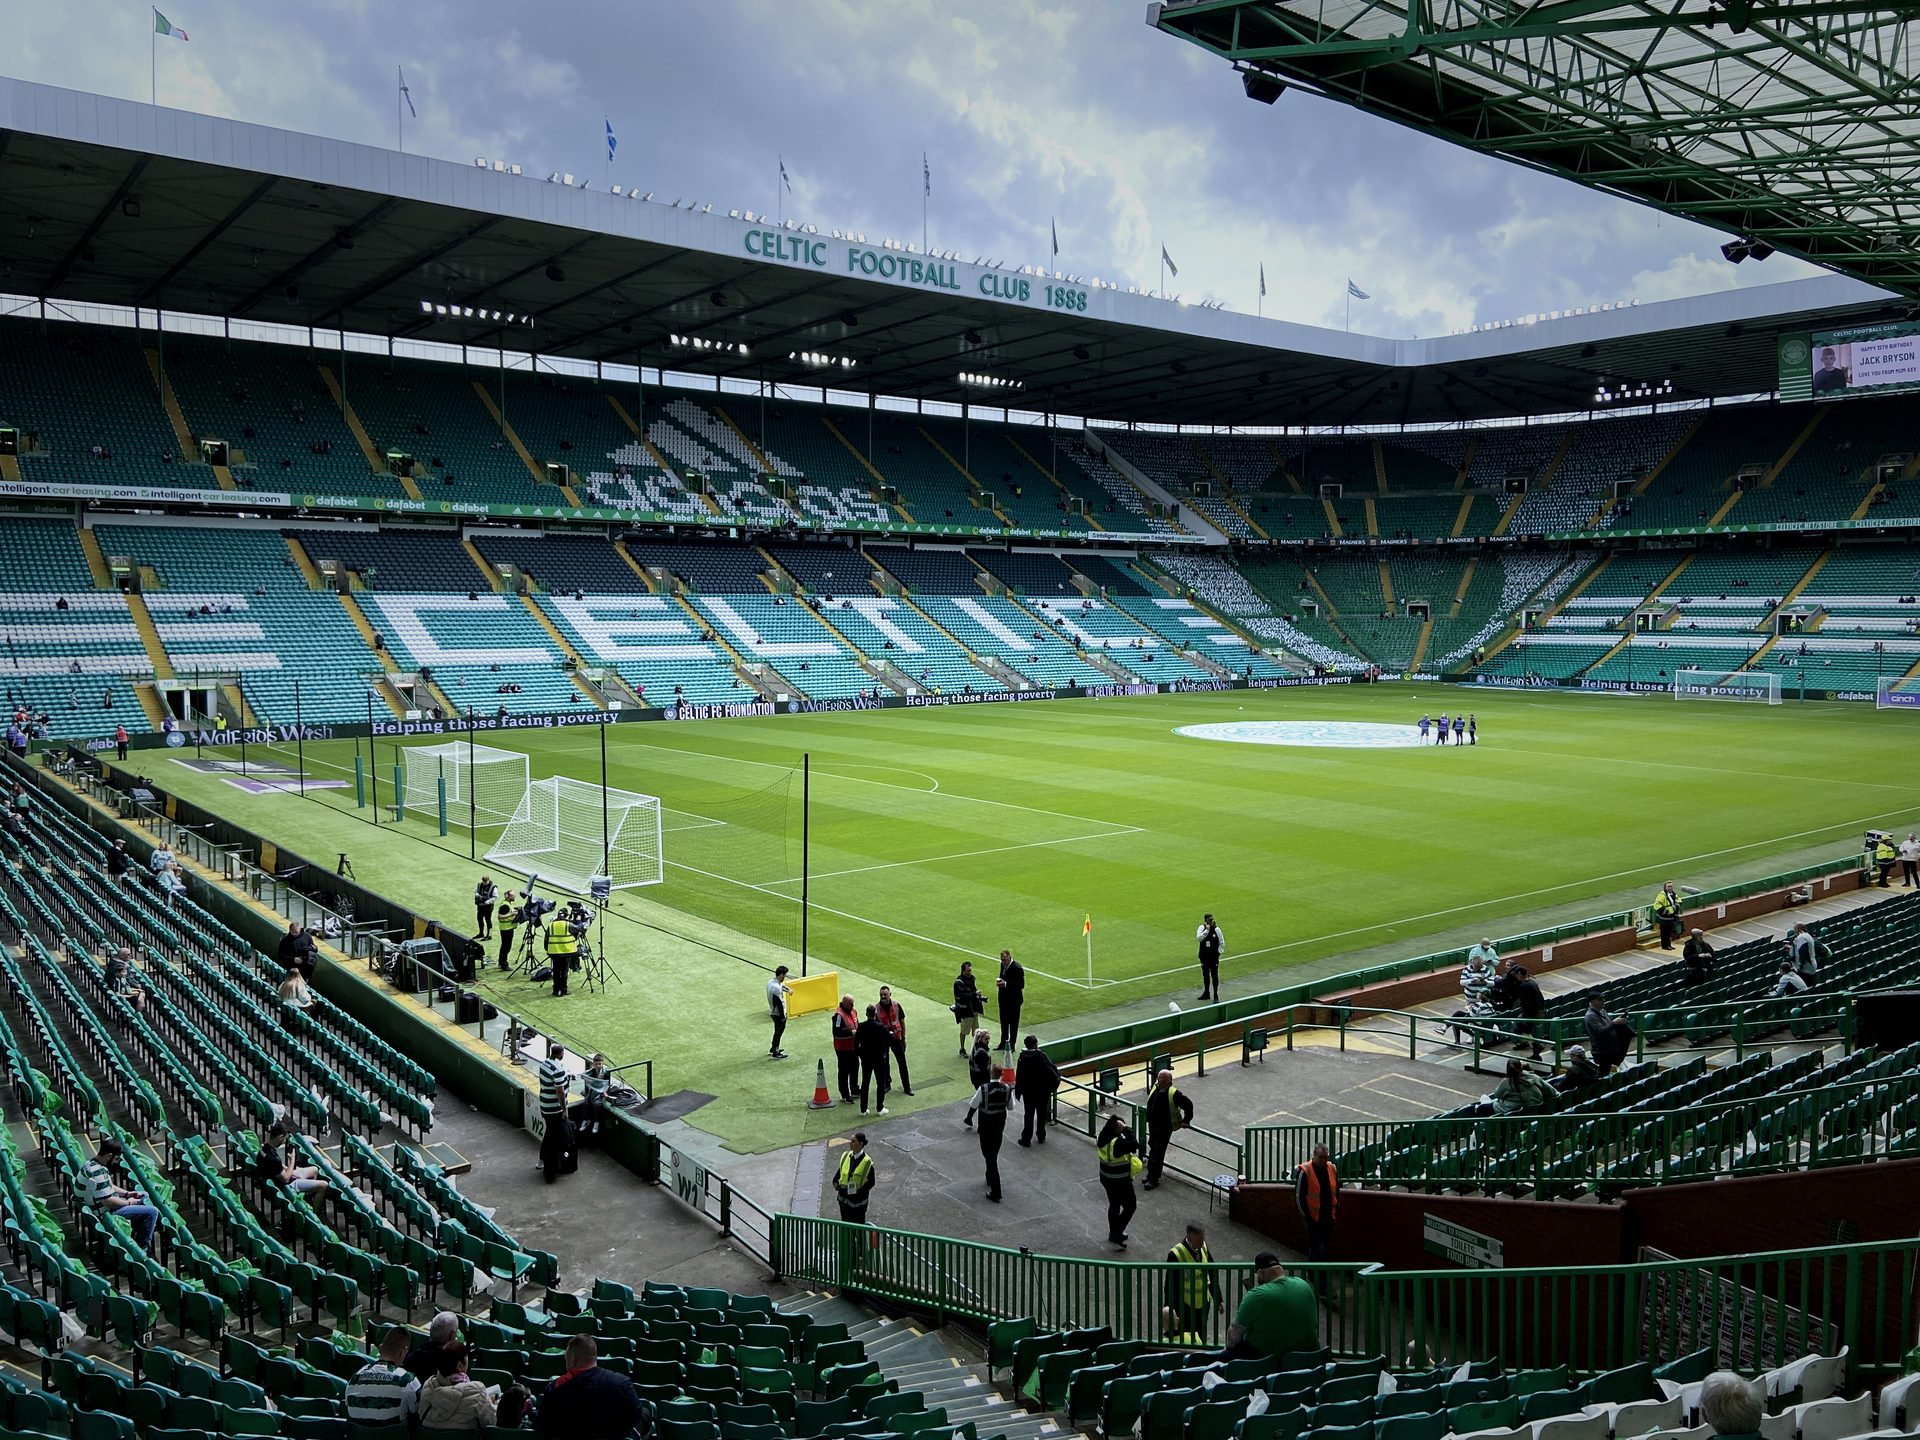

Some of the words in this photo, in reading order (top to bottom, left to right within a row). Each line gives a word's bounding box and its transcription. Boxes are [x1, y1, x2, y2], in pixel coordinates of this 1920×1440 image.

[744, 229, 827, 266] CELTIC
[848, 247, 961, 290] FOOTBALL
[979, 273, 1031, 302] CLUB
[1045, 284, 1088, 312] 1888
[1853, 327, 1882, 335] FOOTBALL
[1860, 356, 1881, 366] JACK
[1882, 352, 1915, 363] BRYSON
[52, 487, 70, 495] car
[203, 493, 220, 501] car
[316, 495, 359, 508] dafabet
[386, 498, 426, 511] dafabet
[452, 502, 489, 513] dafabet
[663, 512, 695, 523] dafabet
[705, 515, 736, 525] dafabet
[978, 527, 1001, 535] dafabet
[1009, 528, 1031, 536] dafabet
[1039, 529, 1061, 537] dafabet
[1067, 530, 1088, 538] dafabet
[1248, 679, 1277, 689] Helping
[1278, 677, 1300, 686] those
[1300, 676, 1324, 686] facing
[1324, 675, 1352, 685] poverty
[1377, 673, 1401, 681] dafabet
[1412, 673, 1440, 681] dafabet
[1094, 686, 1115, 697] CELTIC
[1116, 686, 1124, 696] FC
[1124, 683, 1159, 696] FOUNDATION
[1581, 679, 1627, 691] Helping
[1630, 681, 1664, 692] those
[1710, 687, 1764, 698] poverty
[905, 694, 950, 707] Helping
[951, 693, 981, 703] those
[983, 690, 1016, 702] facing
[1017, 689, 1056, 701] poverty
[1837, 690, 1874, 701] dafabet
[1891, 694, 1916, 703] cinch
[852, 698, 884, 710] Wish
[679, 704, 709, 720] CELTIC
[711, 703, 723, 718] FC
[725, 702, 776, 718] FOUNDATION
[371, 720, 444, 736] Helping
[448, 716, 497, 731] those
[501, 714, 553, 729] facing
[557, 711, 619, 726] poverty
[279, 725, 333, 742] Wish
[86, 737, 119, 751] dafab
[531, 1115, 545, 1137] W2
[677, 1172, 698, 1208] W1
[1451, 1237, 1475, 1256] TOILETS
[1446, 1248, 1464, 1264] FOOD
[1465, 1255, 1479, 1269] BAR
